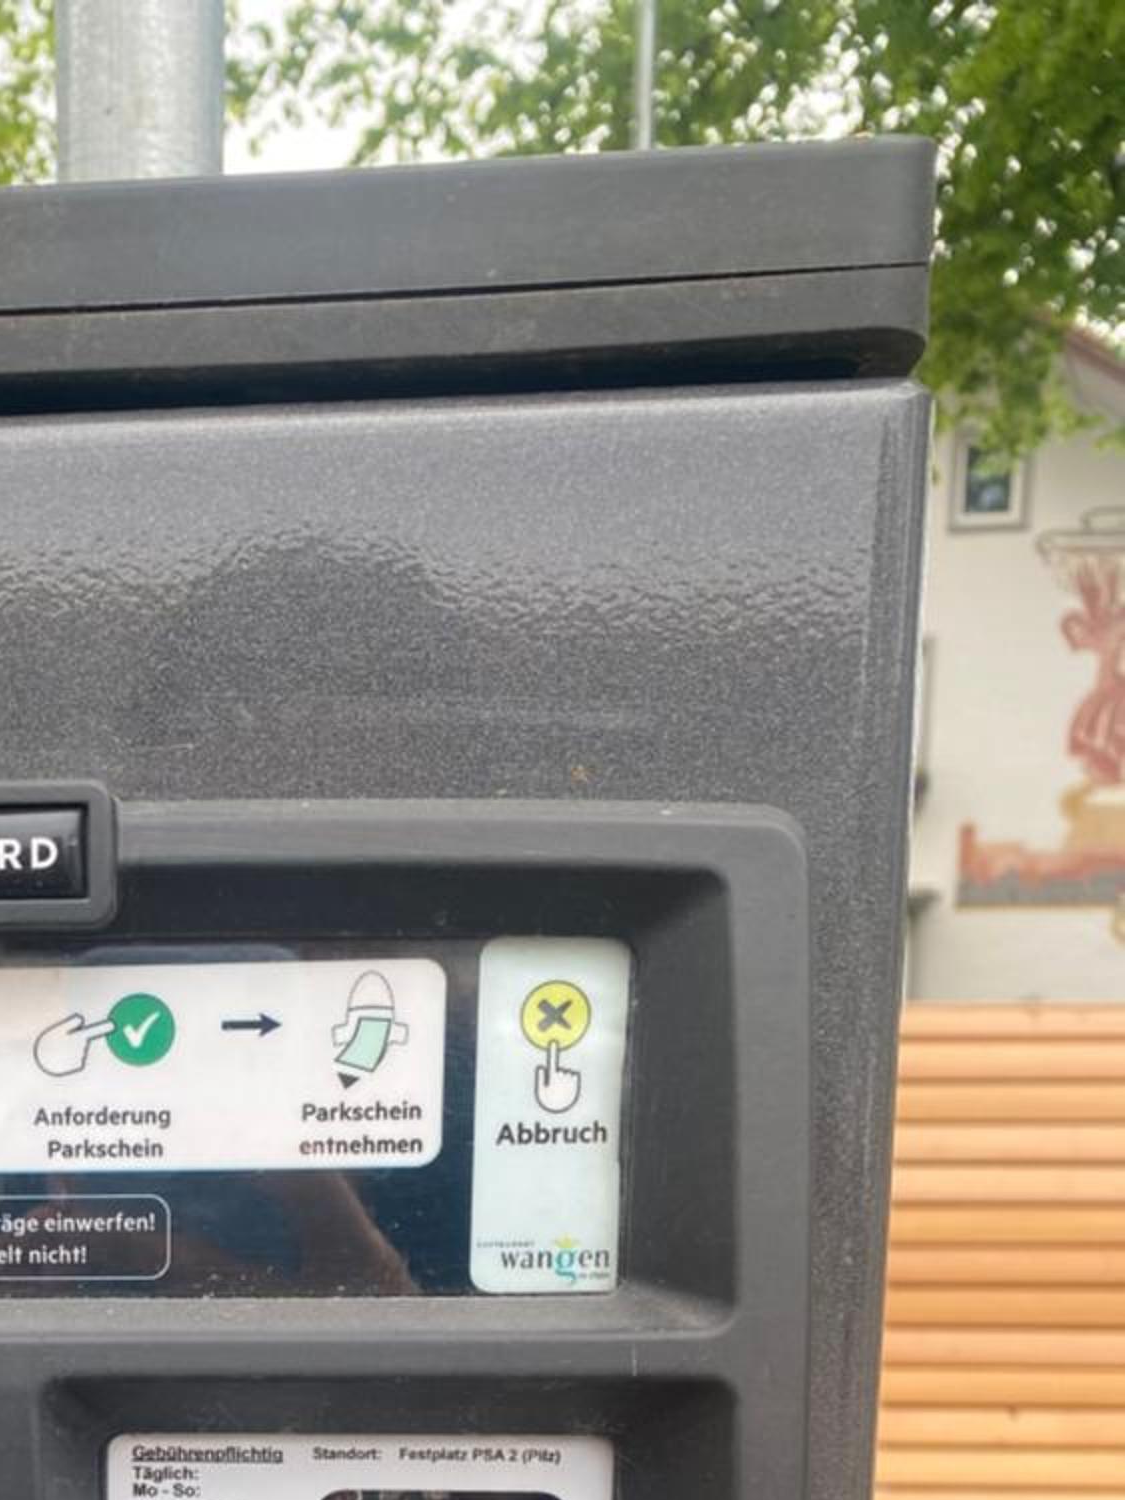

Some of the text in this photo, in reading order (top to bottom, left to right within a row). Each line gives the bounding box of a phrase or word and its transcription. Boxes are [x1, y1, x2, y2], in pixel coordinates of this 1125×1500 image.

[34, 1107, 172, 1129] Anforderung
[301, 1101, 423, 1122] Parkschein
[496, 1121, 608, 1146] Abbruch
[47, 1139, 164, 1159] Parkschein
[298, 1136, 424, 1156] entnehmen
[44, 1212, 156, 1233] einwerfen!
[28, 1244, 88, 1264] nicht!
[500, 1248, 610, 1285] wangen
[132, 1444, 284, 1464] Gebührenpflichtig
[312, 1446, 562, 1465] Standort: Festplatz PSA 2 (Pilz)
[132, 1466, 200, 1482] Täglich:
[132, 1483, 158, 1497] Mo
[172, 1483, 202, 1497] So:
